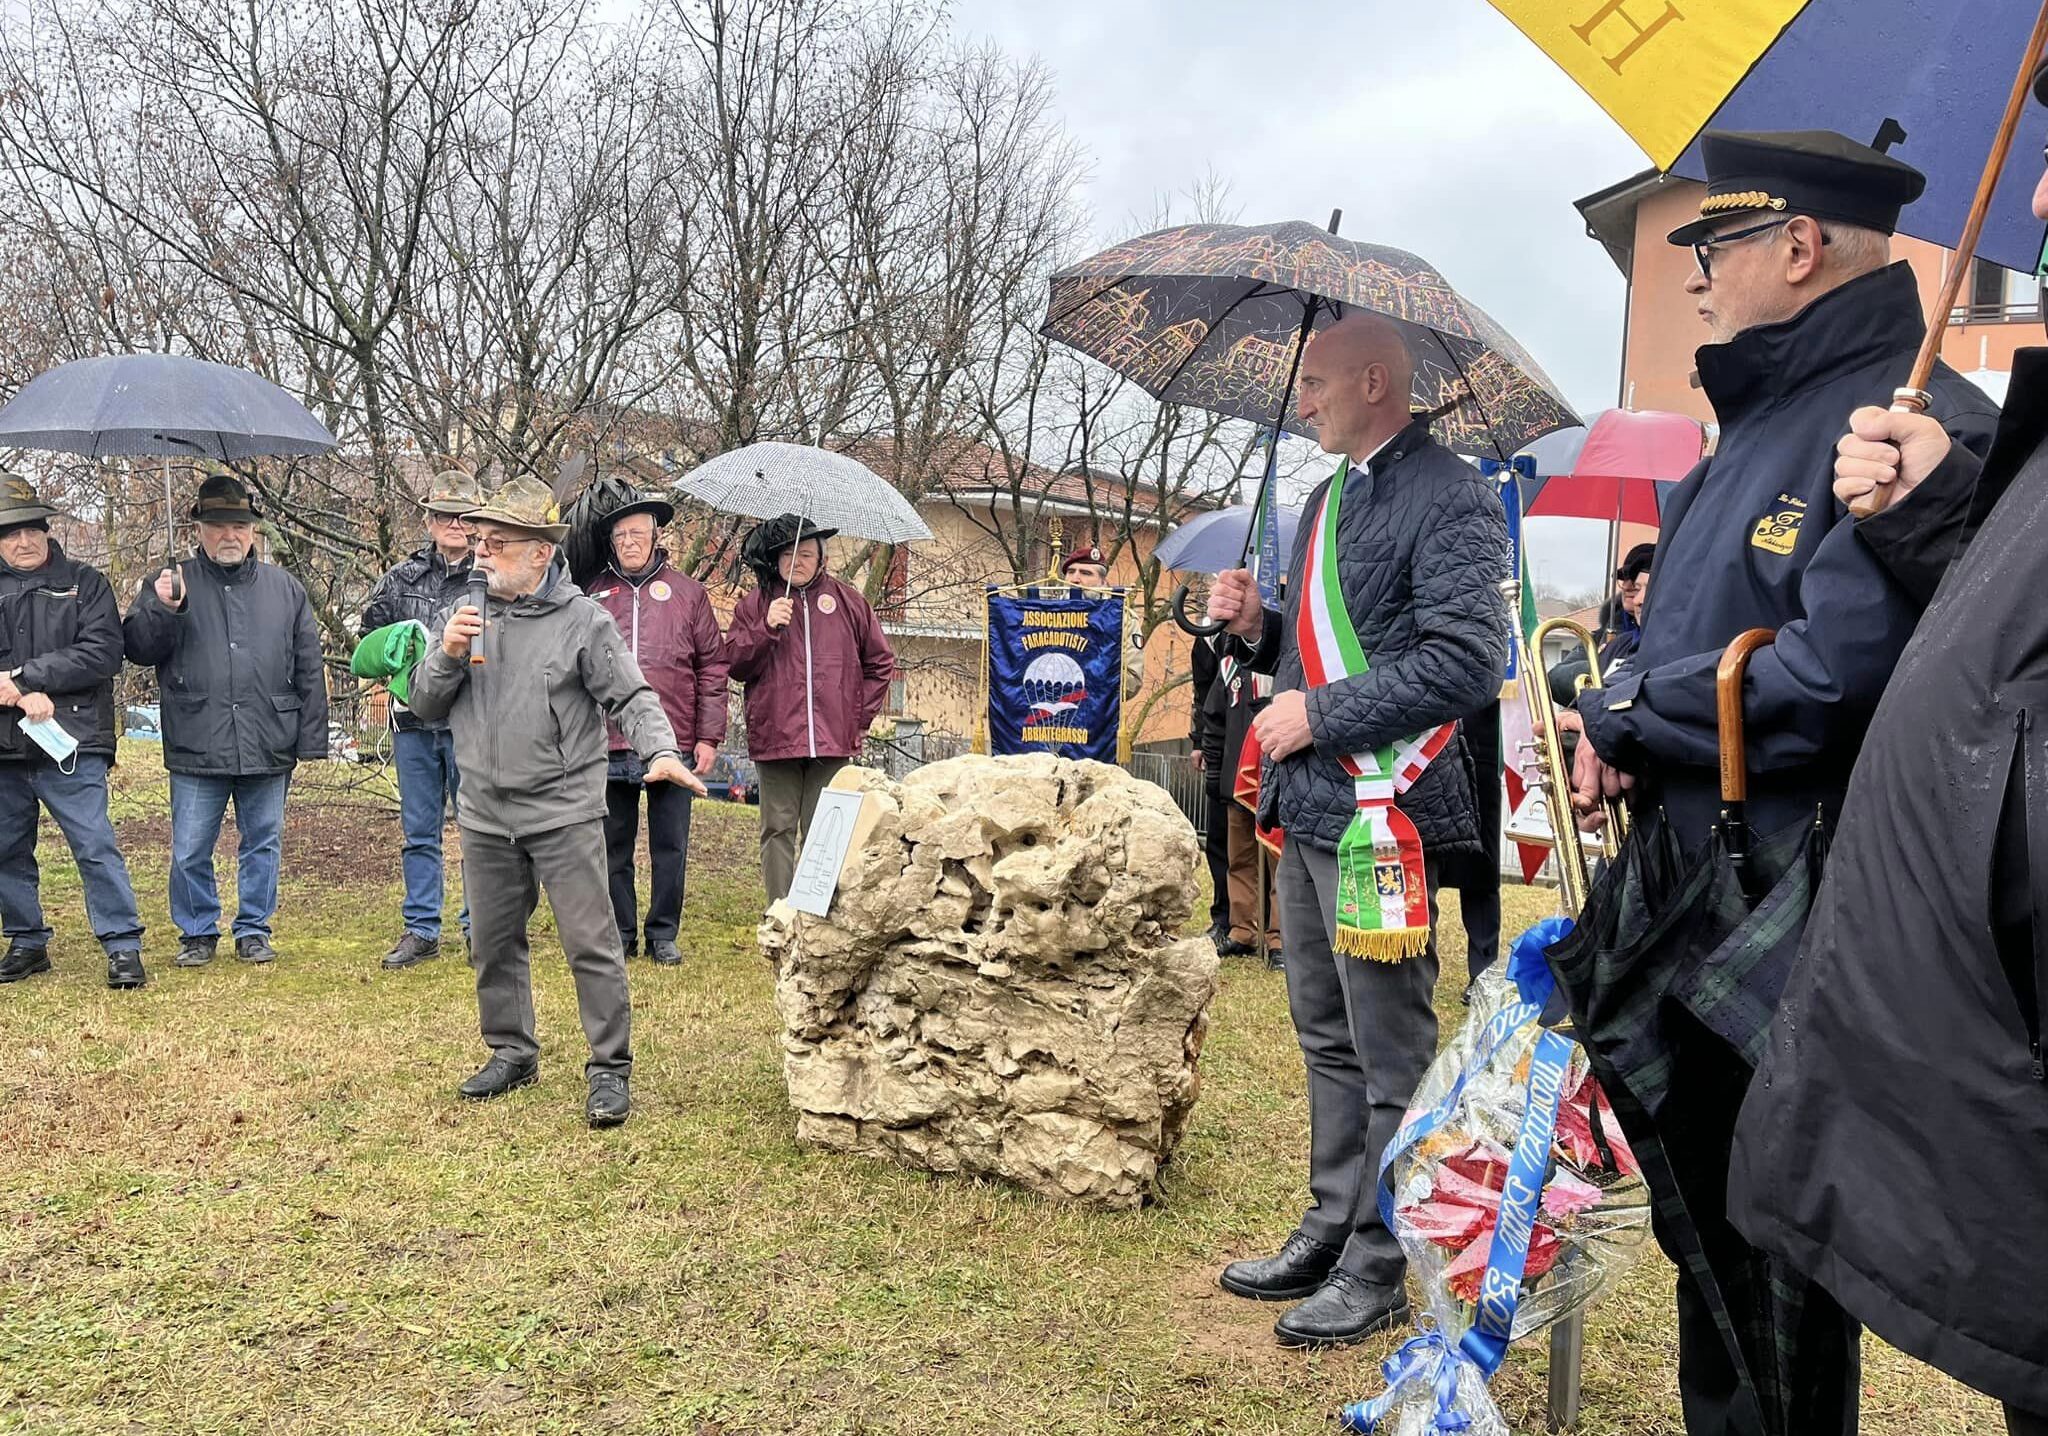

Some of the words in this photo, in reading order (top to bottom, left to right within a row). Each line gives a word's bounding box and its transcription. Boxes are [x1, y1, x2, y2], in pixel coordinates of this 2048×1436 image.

[1022, 611, 1088, 628] ASSOCIAZIONE
[1022, 632, 1088, 652] PARACADUTISTI
[1022, 726, 1087, 744] ABBIATEGRASSO
[1498, 1175, 1536, 1256] Delle
